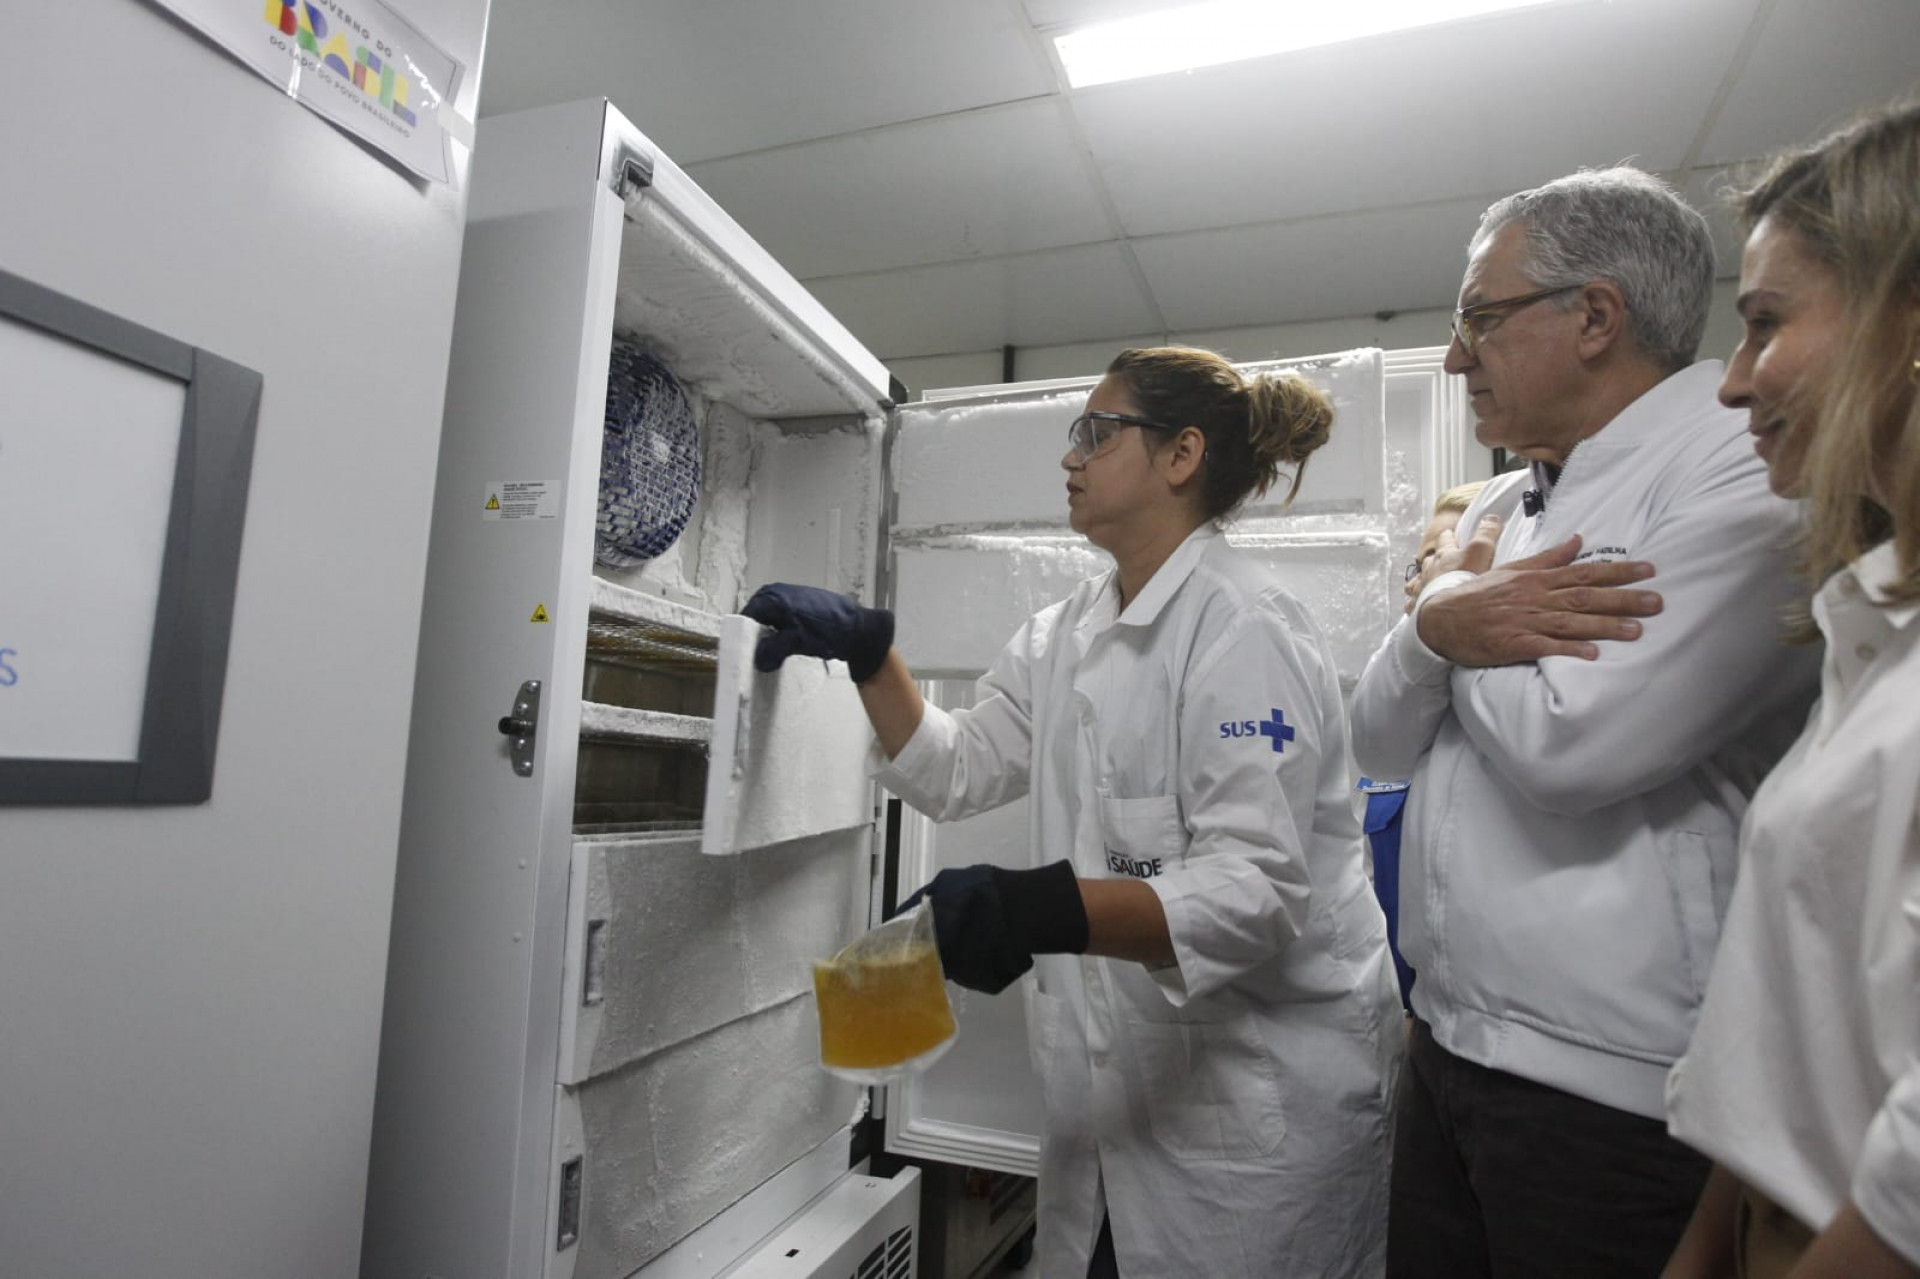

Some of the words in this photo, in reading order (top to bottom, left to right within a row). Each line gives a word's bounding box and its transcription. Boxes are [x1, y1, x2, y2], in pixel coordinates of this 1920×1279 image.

[319, 0, 370, 40] VERNO
[376, 40, 393, 58] DO
[269, 35, 287, 51] DO
[1220, 720, 1257, 738] SUS
[1110, 856, 1163, 878] SAÚDE
